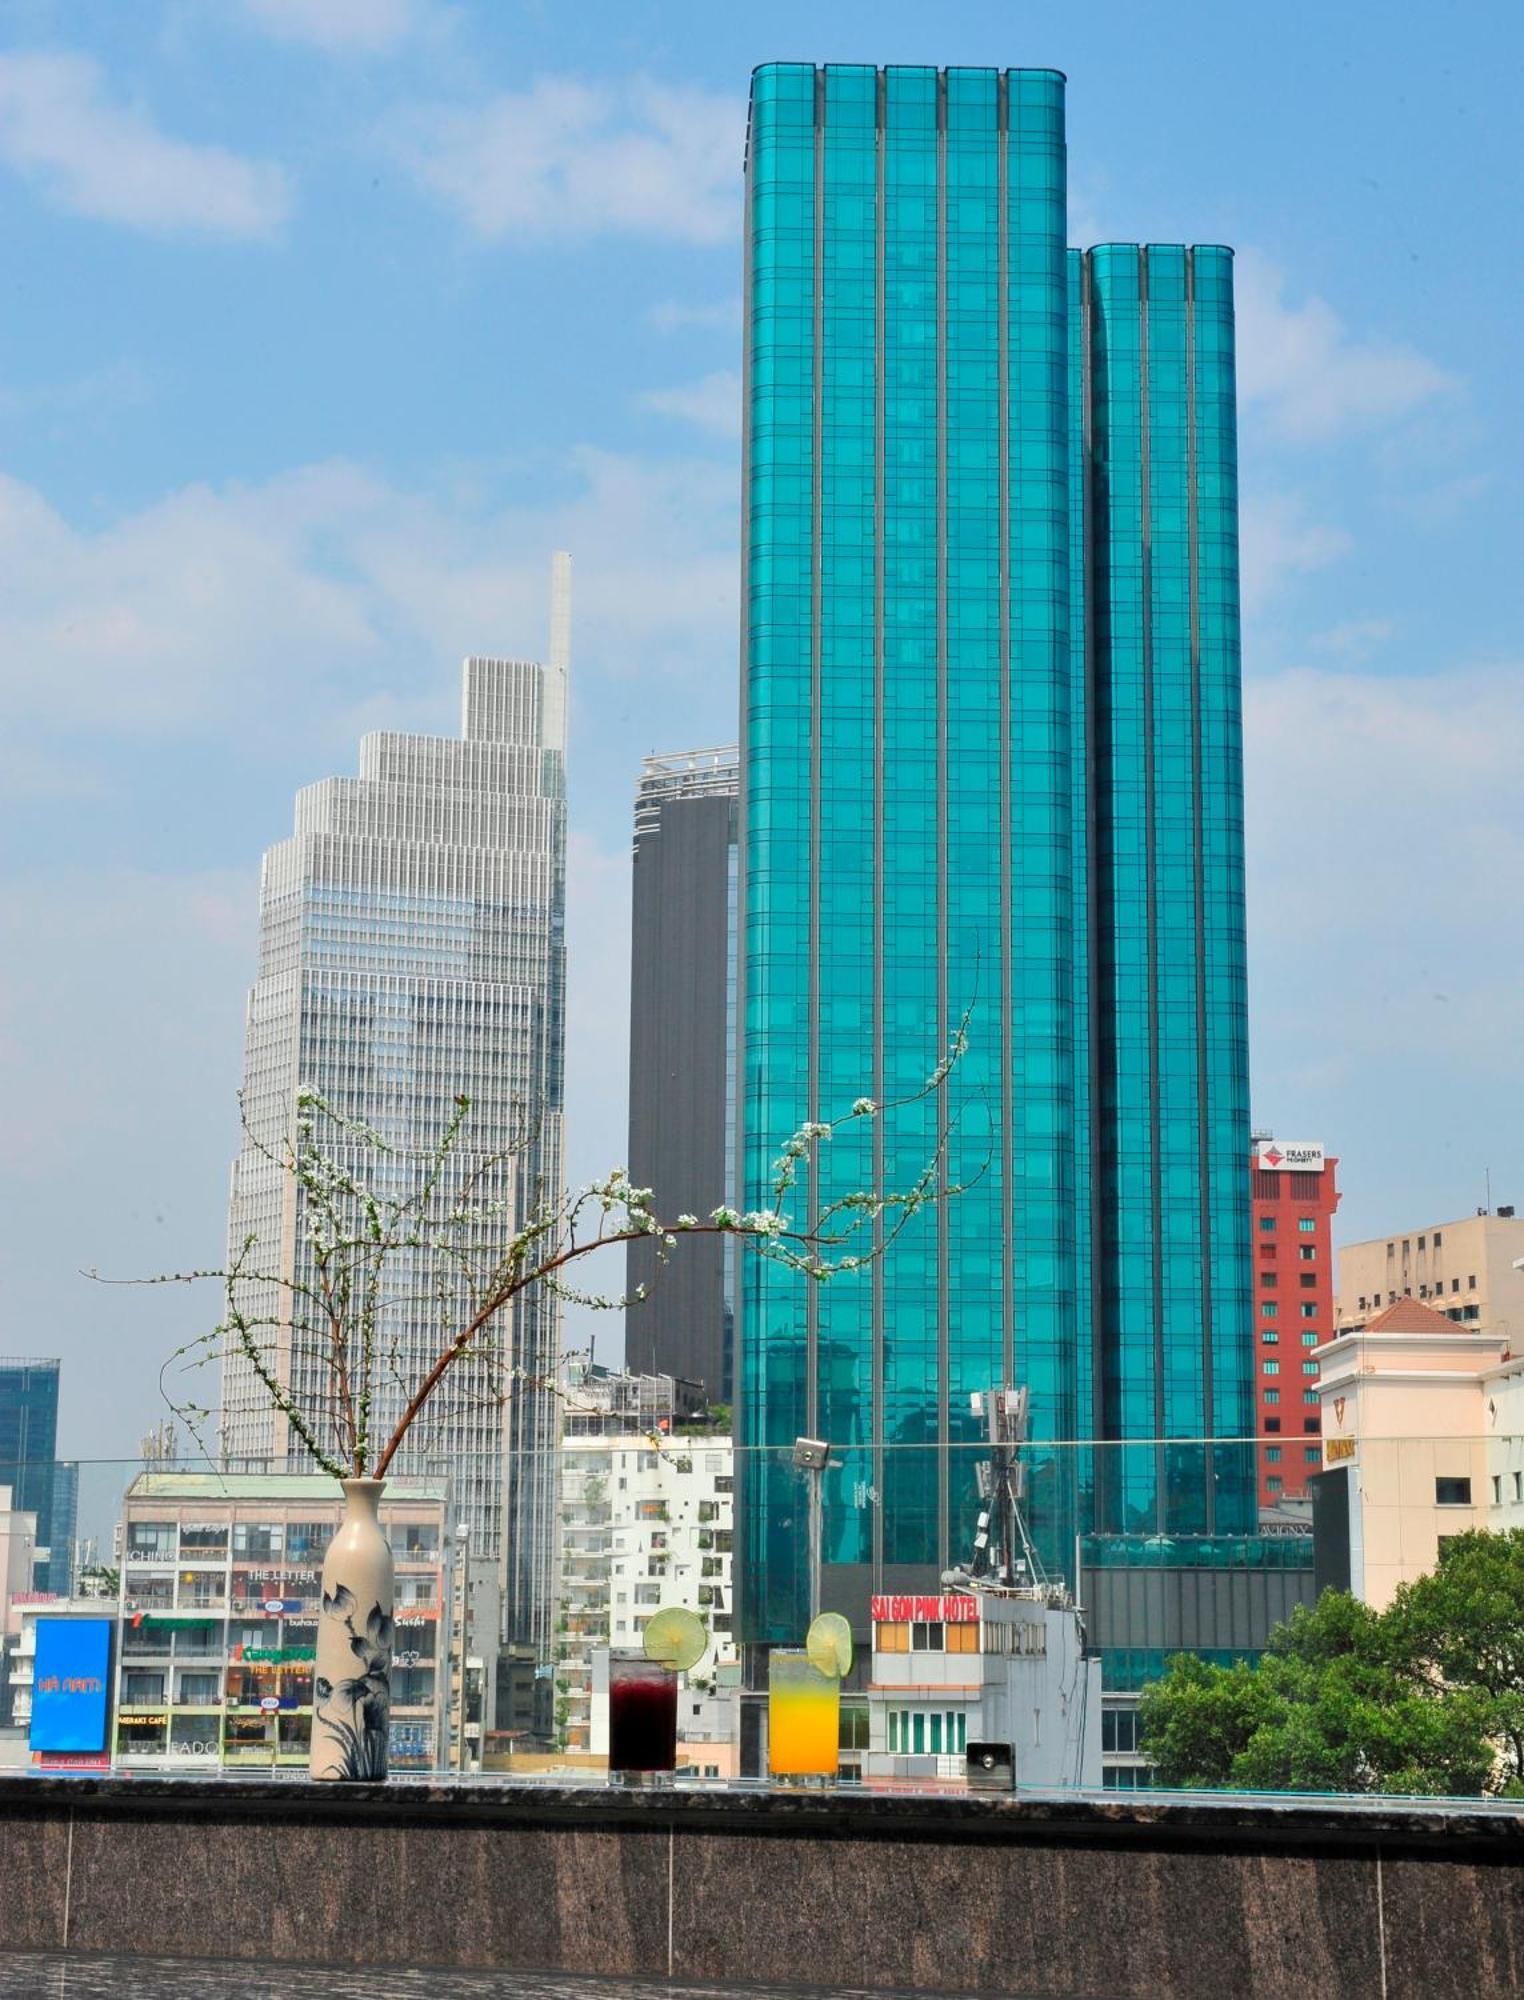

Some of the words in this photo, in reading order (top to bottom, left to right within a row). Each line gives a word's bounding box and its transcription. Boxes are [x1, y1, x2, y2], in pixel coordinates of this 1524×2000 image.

[1286, 1150, 1322, 1158] FRASERS
[249, 1570, 270, 1580] THE
[273, 1571, 315, 1580] LETTER
[942, 1596, 979, 1622] HOTEL
[250, 1665, 268, 1674] THE
[271, 1665, 310, 1674] LETTER
[119, 1716, 147, 1725] MERAKI
